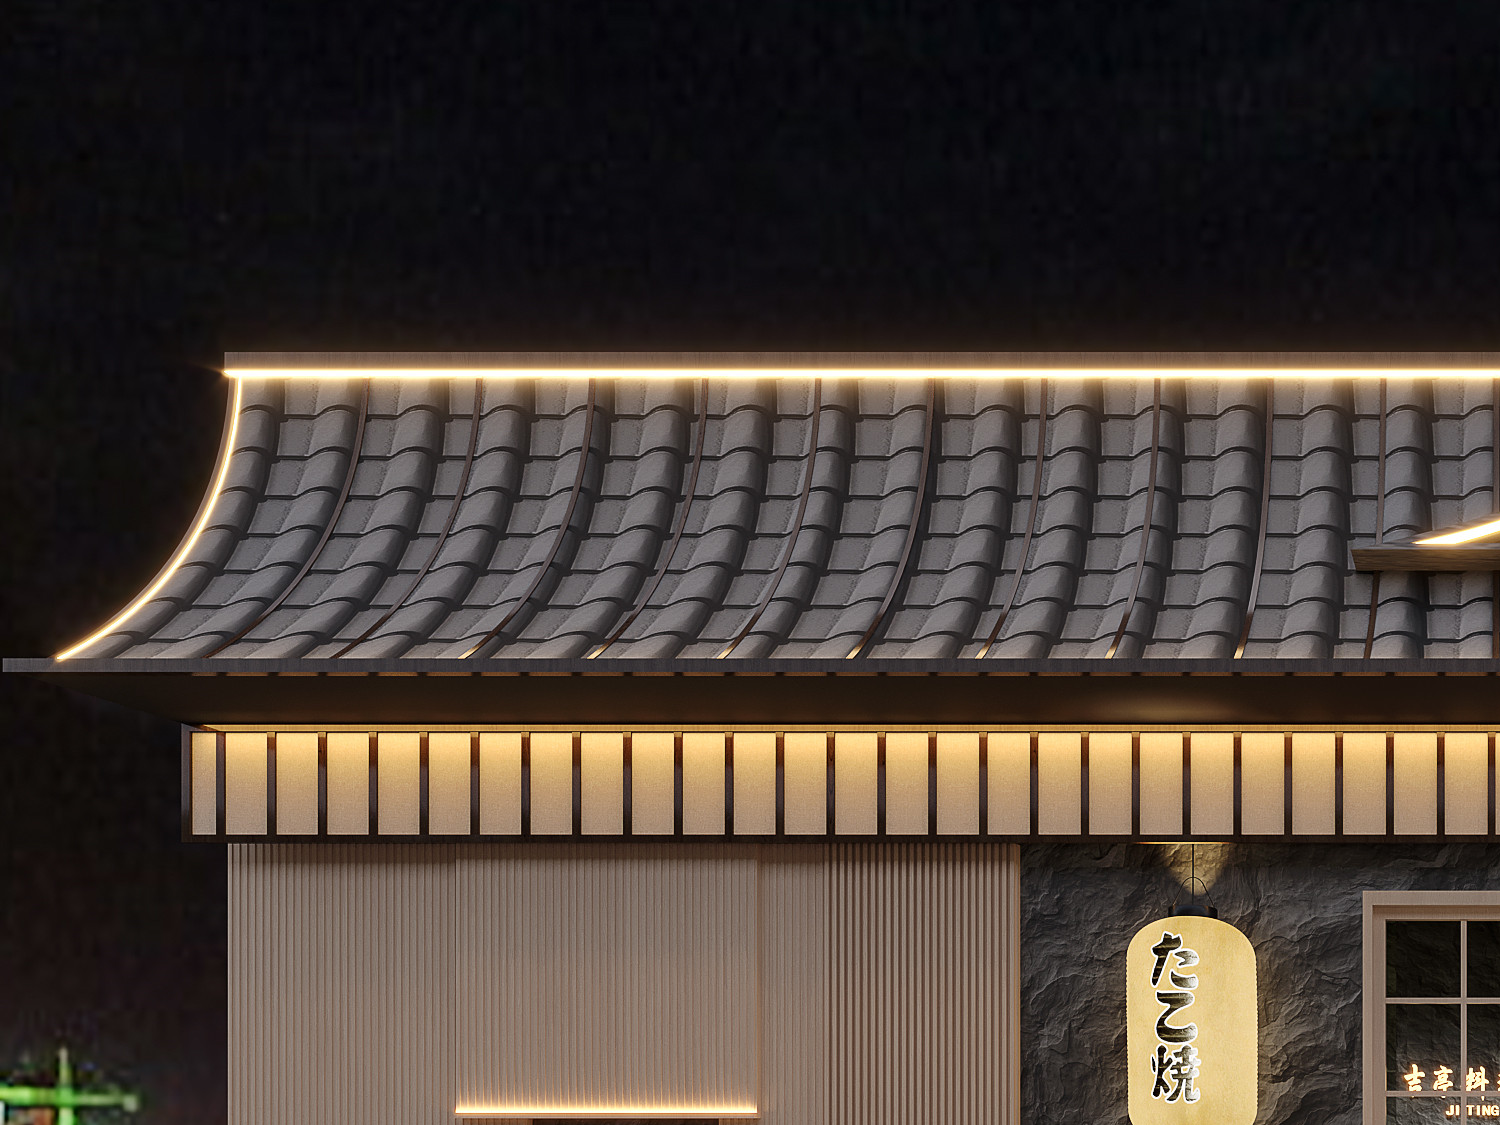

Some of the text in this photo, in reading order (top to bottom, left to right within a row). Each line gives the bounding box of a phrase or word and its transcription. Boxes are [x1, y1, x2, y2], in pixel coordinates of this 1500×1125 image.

[1150, 930, 1202, 1105] たこ焼
[1466, 1104, 1500, 1117] TING
